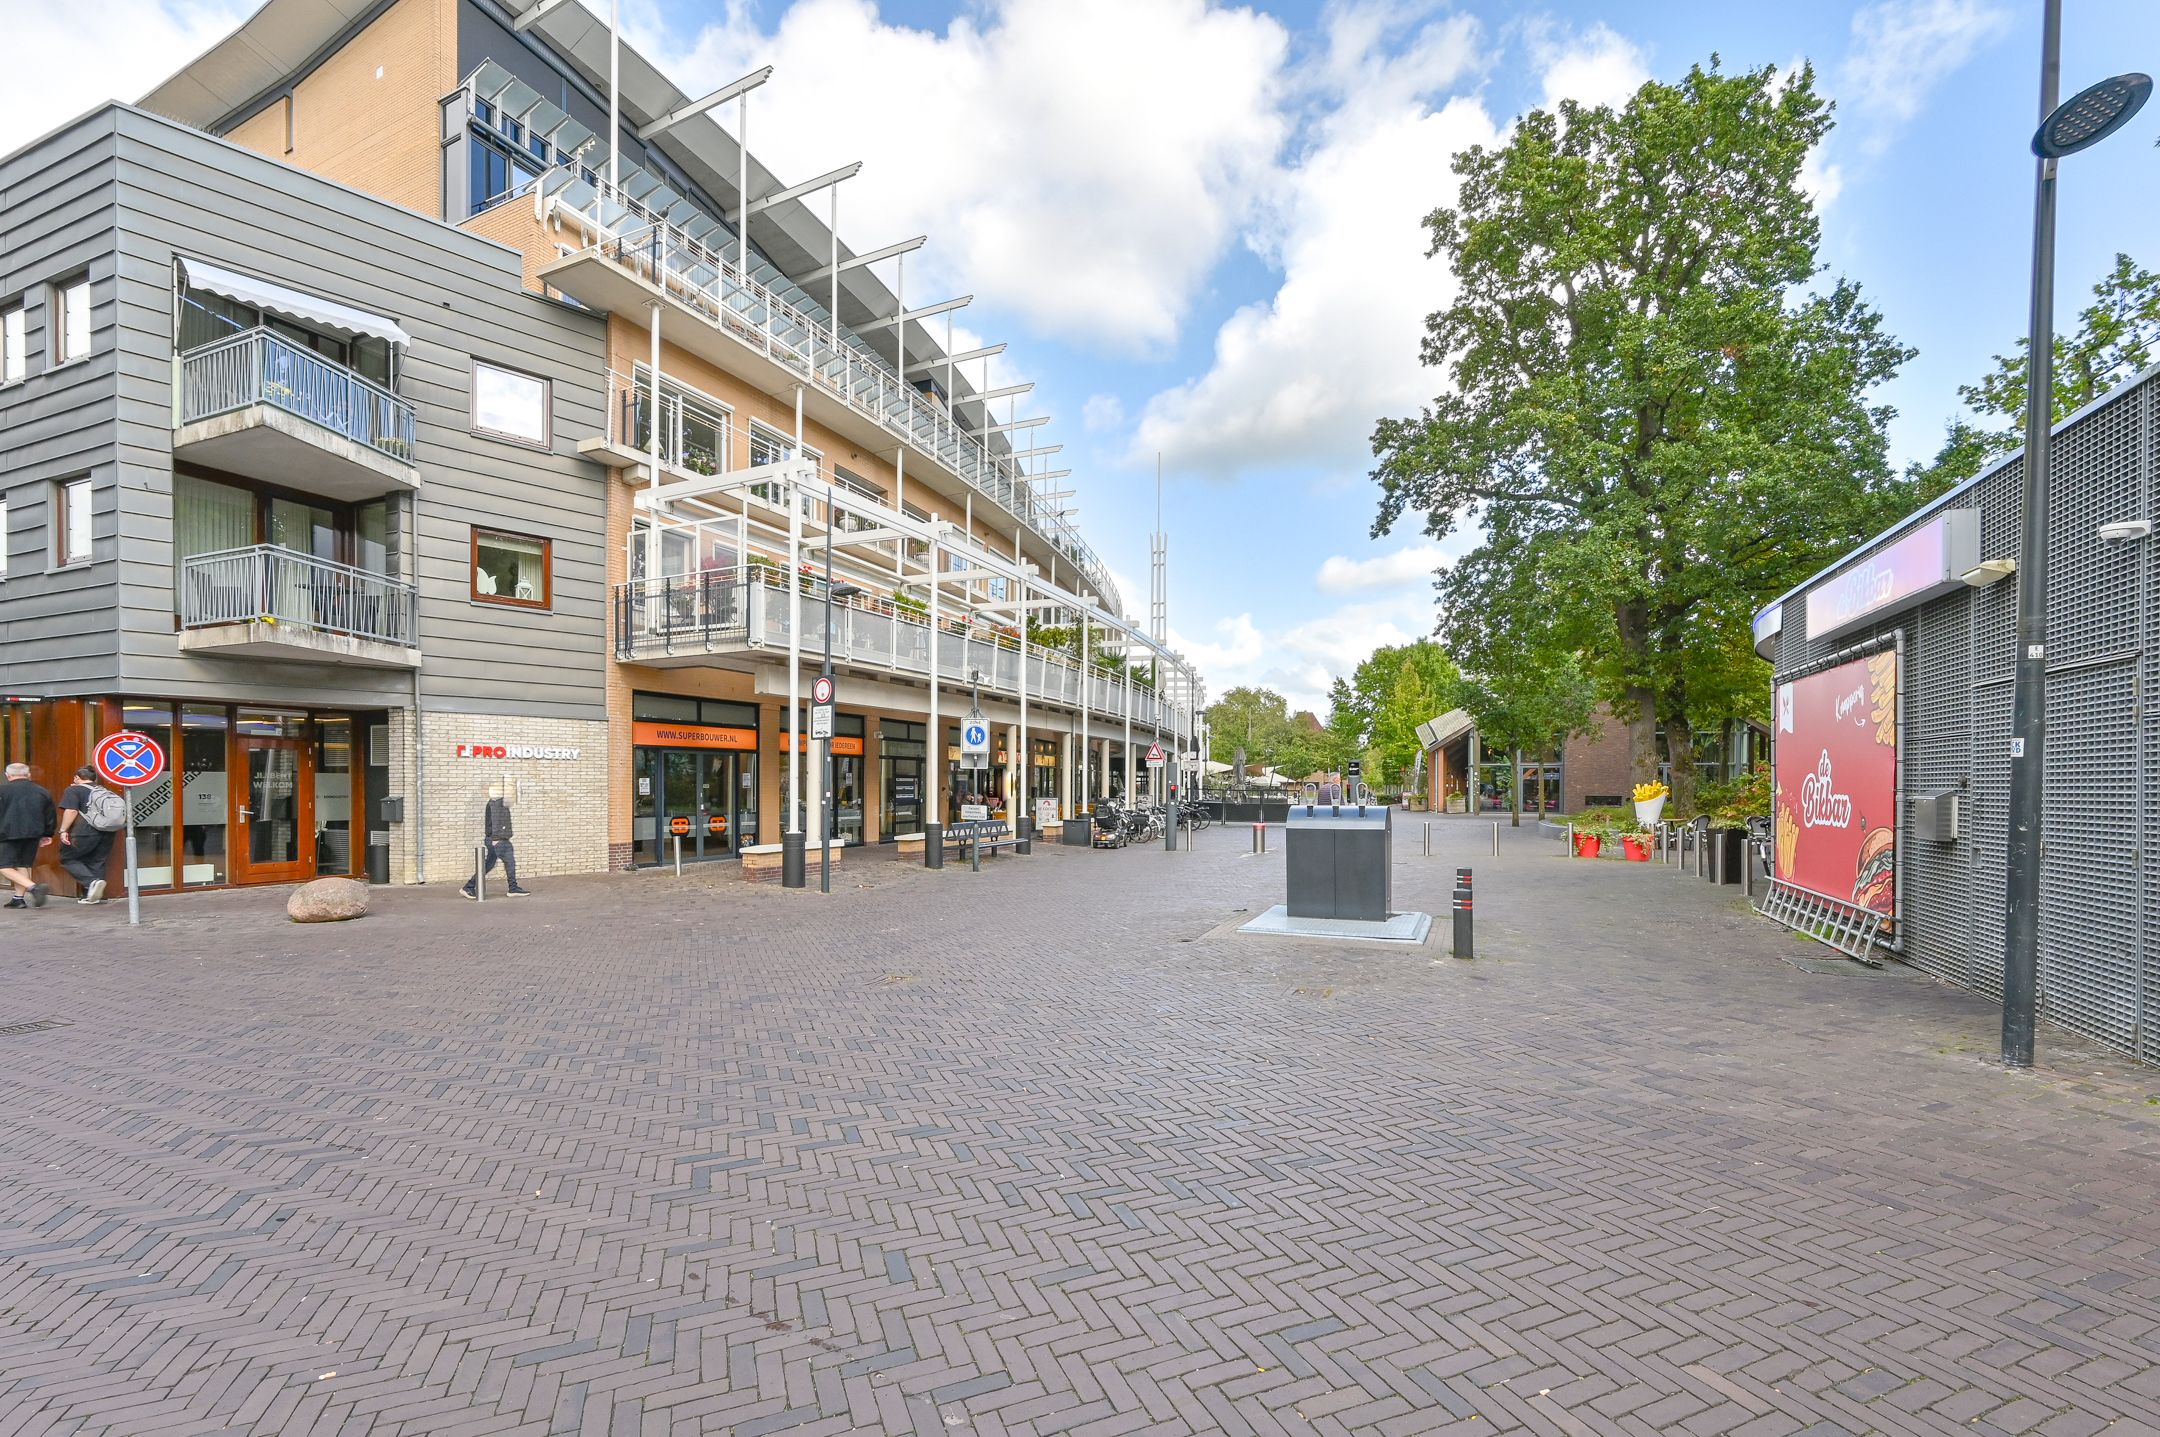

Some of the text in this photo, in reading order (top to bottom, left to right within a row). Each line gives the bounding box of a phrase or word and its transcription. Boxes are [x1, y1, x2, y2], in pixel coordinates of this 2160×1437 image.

[656, 730, 738, 743] WWW.SUPERBOUWER.NL
[1819, 750, 1831, 778] de
[1802, 773, 1851, 828] Bikbar
